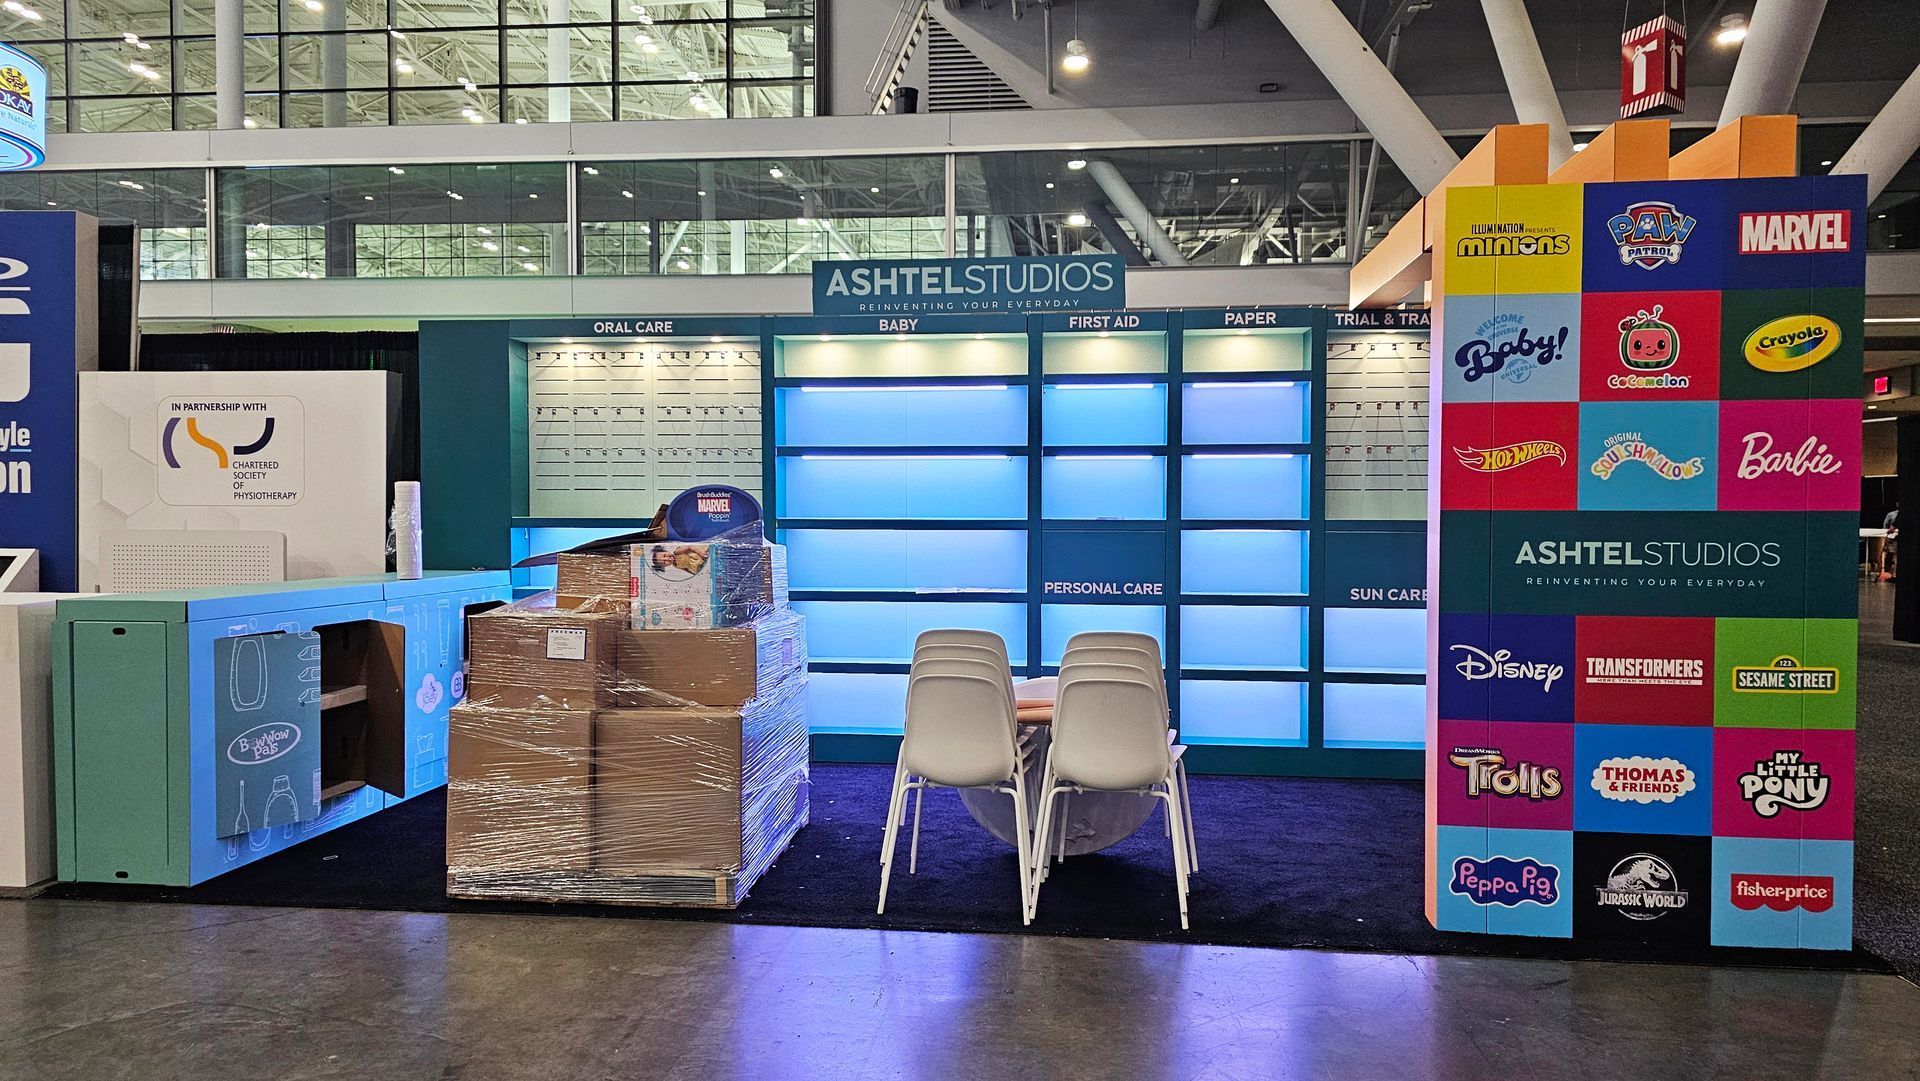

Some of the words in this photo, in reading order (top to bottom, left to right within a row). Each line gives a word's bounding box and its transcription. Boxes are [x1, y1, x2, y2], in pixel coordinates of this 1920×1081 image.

[1471, 223, 1524, 234] ILLUMINATION
[1607, 212, 1697, 246] PAW
[1741, 213, 1848, 252] MARVEL
[1627, 247, 1674, 257] PATROL
[859, 302, 954, 311] REINVENTING
[962, 301, 999, 309] YOUR
[1007, 299, 1080, 308] EVERYDAY
[879, 319, 918, 331] BABY
[1069, 316, 1110, 328] FIRST
[1113, 315, 1140, 328] AID
[1224, 312, 1276, 325] PAPER
[1335, 312, 1379, 326] TRIAL
[1383, 313, 1395, 326] &
[1475, 313, 1525, 336] WELCOME
[593, 321, 633, 334] ORAL
[635, 321, 673, 333] CARE
[1759, 326, 1823, 348] Crayola
[1455, 326, 1569, 382] Baby!
[1500, 362, 1538, 380] UNIVERSAL
[171, 403, 181, 411] IN
[183, 403, 240, 411] PARTNERSHIP
[243, 403, 267, 411] WITH
[1604, 432, 1642, 448] ORIGINAL
[1591, 441, 1704, 480] SQUISHMALLOWS
[1737, 431, 1842, 480] Barbie
[232, 461, 279, 469] CHARTERED
[233, 471, 266, 479] SOCIETY
[233, 481, 244, 490] OF
[233, 491, 297, 500] PHYSIOTHERAPY
[697, 499, 731, 512] MARVEL
[1044, 582, 1121, 594] PERSONAL
[1123, 583, 1163, 595] CARE
[1526, 577, 1629, 586] REINVENTING
[1638, 578, 1677, 586] YOUR
[1687, 579, 1765, 588] EVERYDAY
[1350, 588, 1383, 600] SUN
[1586, 657, 1704, 678] TRANSFORMERS
[1738, 672, 1786, 688] SESAME
[1788, 672, 1834, 688] STREET
[253, 742, 279, 760] Pals
[1776, 752, 1800, 764] MY
[1449, 754, 1562, 798] Trolls
[1602, 767, 1685, 783] THOMAS
[1609, 782, 1619, 792] &
[1622, 782, 1679, 794] FRIENDS
[1740, 774, 1828, 816] PONY
[1460, 862, 1519, 897] Peppa
[1522, 865, 1551, 896] Pig
[1736, 881, 1828, 902] fisher-price
[1598, 891, 1642, 906] JURASSIC
[1643, 893, 1686, 908] WORLD
